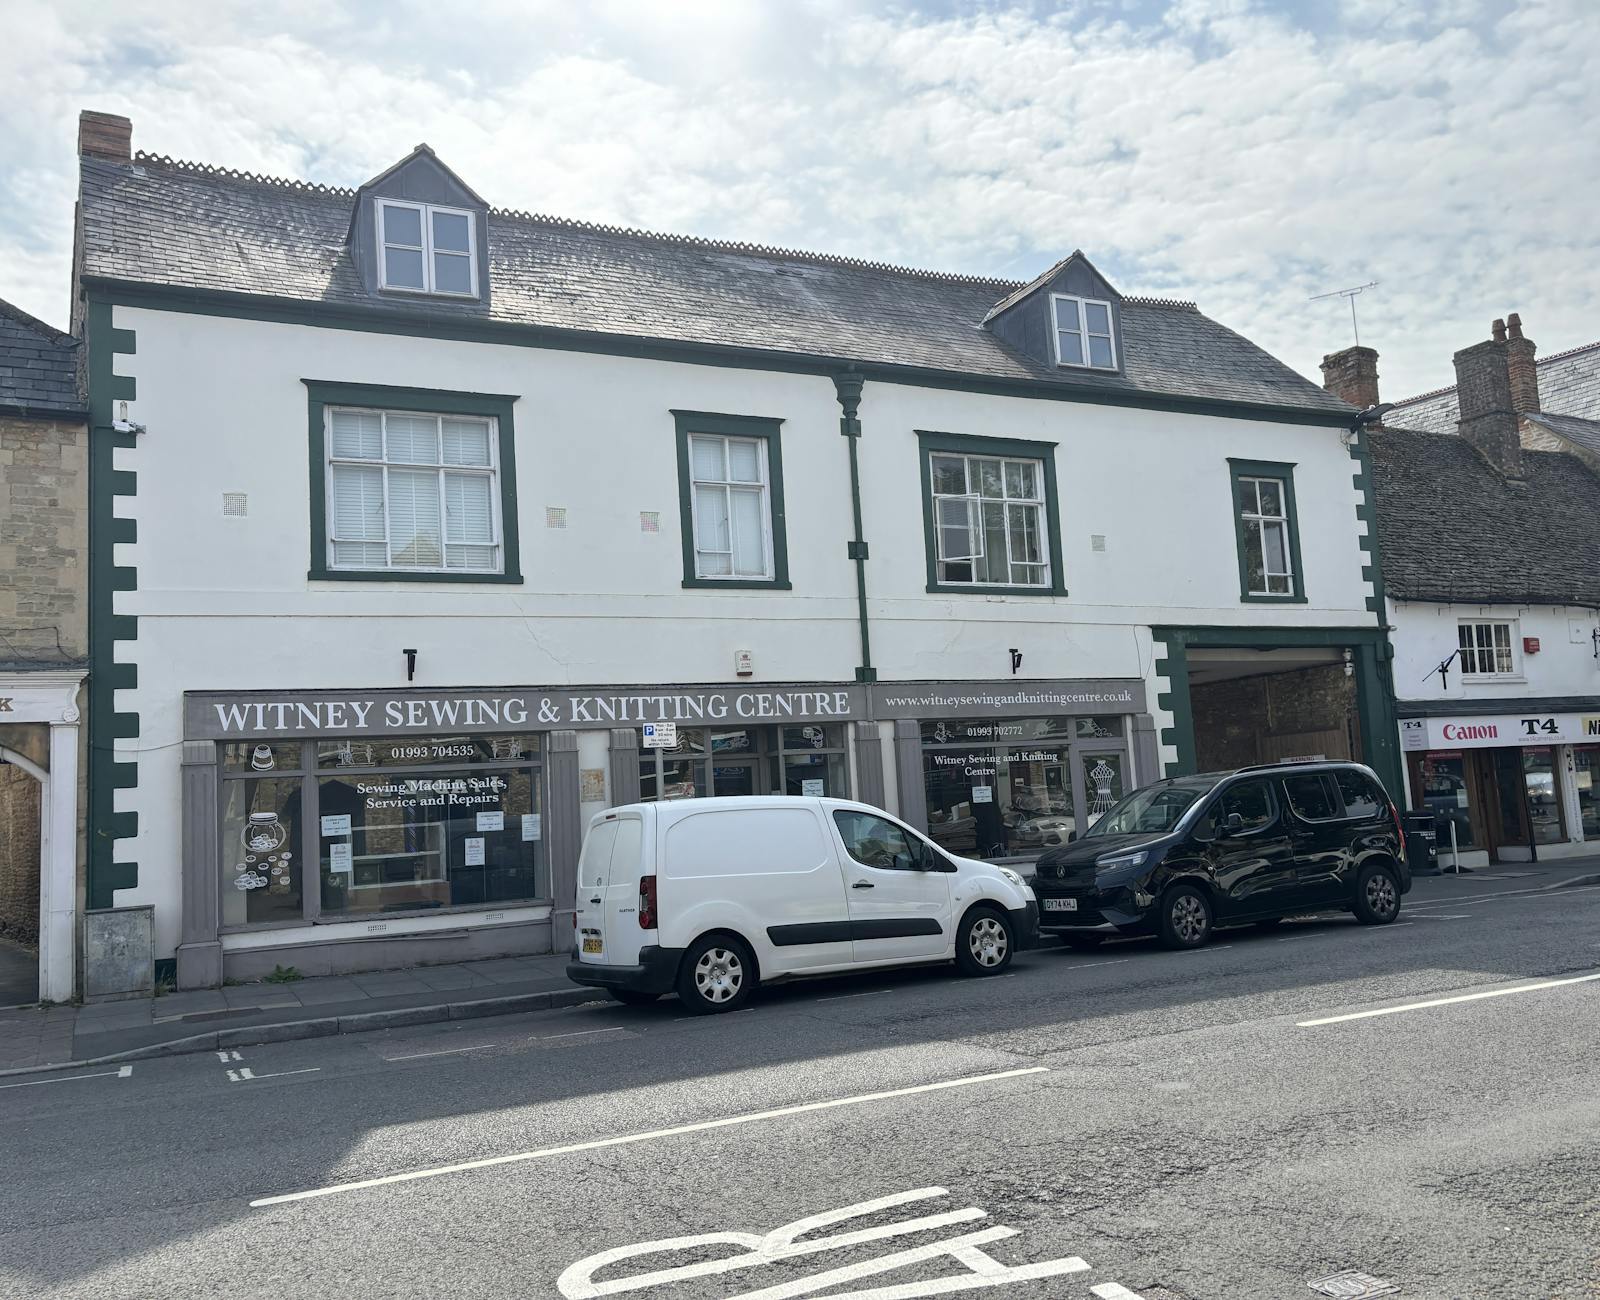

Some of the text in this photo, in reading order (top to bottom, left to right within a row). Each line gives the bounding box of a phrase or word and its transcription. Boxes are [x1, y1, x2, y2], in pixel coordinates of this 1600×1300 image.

[886, 690, 1131, 708] www.witneysewingandknittingcentre.co.uk
[214, 692, 850, 731] WITNEY SEWING & KNITTING CENTRE
[967, 726, 1023, 737] 01993 702772
[1403, 721, 1422, 729] T4
[1442, 724, 1498, 740] Canon
[1521, 718, 1559, 735] T4
[391, 744, 474, 759] 01993 704535
[934, 752, 1058, 766] Witney Sewing and Knitting
[964, 767, 996, 776] Centre
[357, 781, 407, 796] Sewing
[409, 778, 467, 793] Machine
[468, 776, 507, 790] Sales,
[366, 791, 499, 809] Service and Repairs
